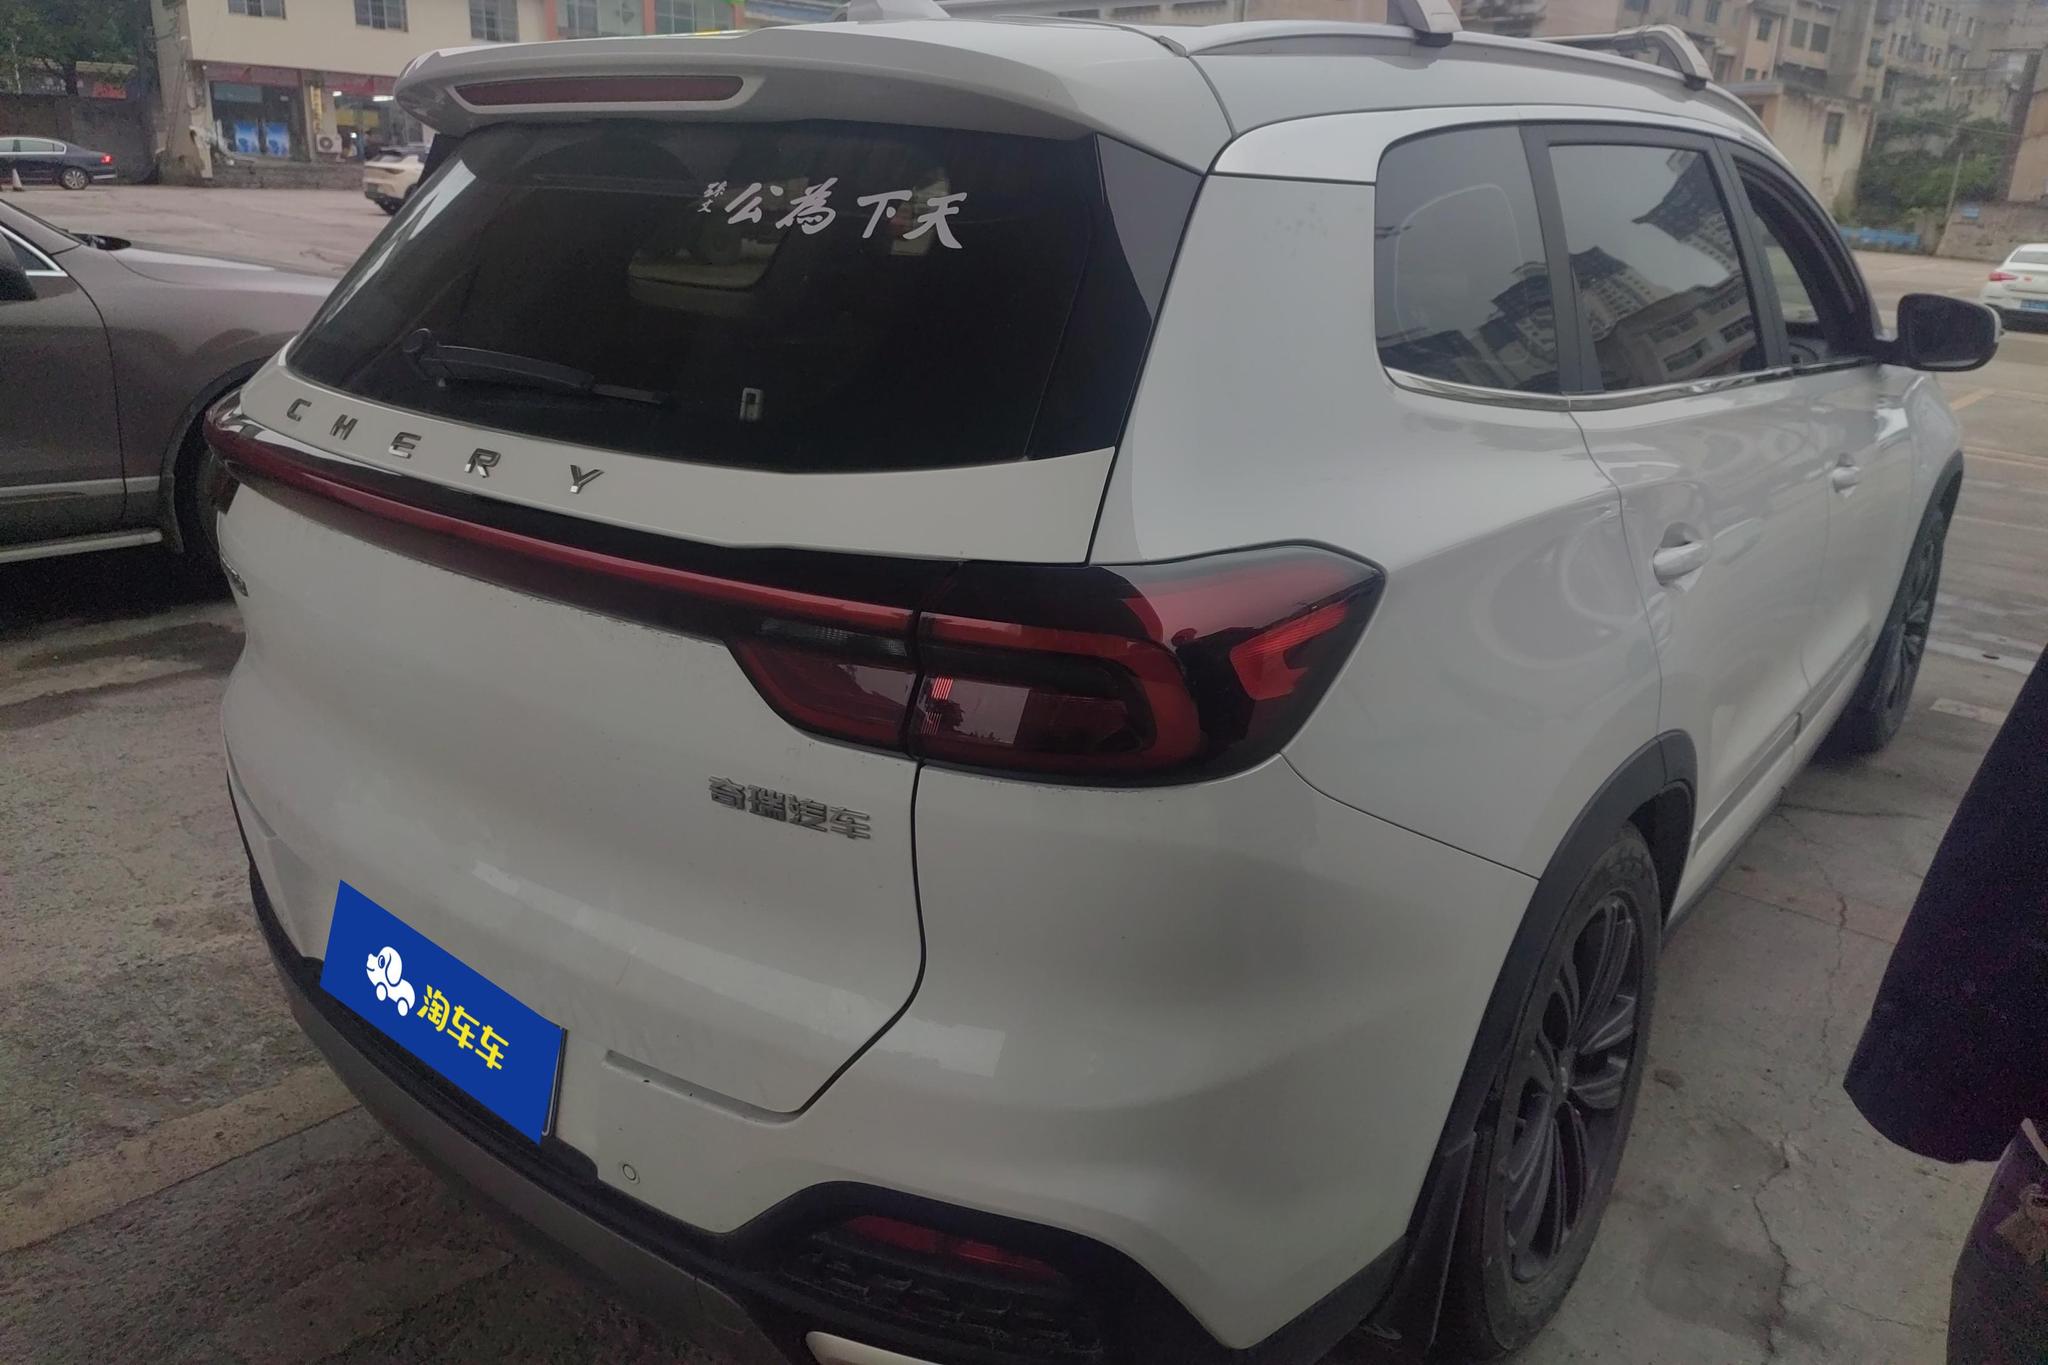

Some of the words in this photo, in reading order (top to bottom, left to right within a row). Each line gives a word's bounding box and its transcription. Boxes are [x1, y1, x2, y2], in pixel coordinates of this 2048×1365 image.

[286, 398, 604, 494] CHERY
[708, 775, 871, 840] 奇瑞汽车
